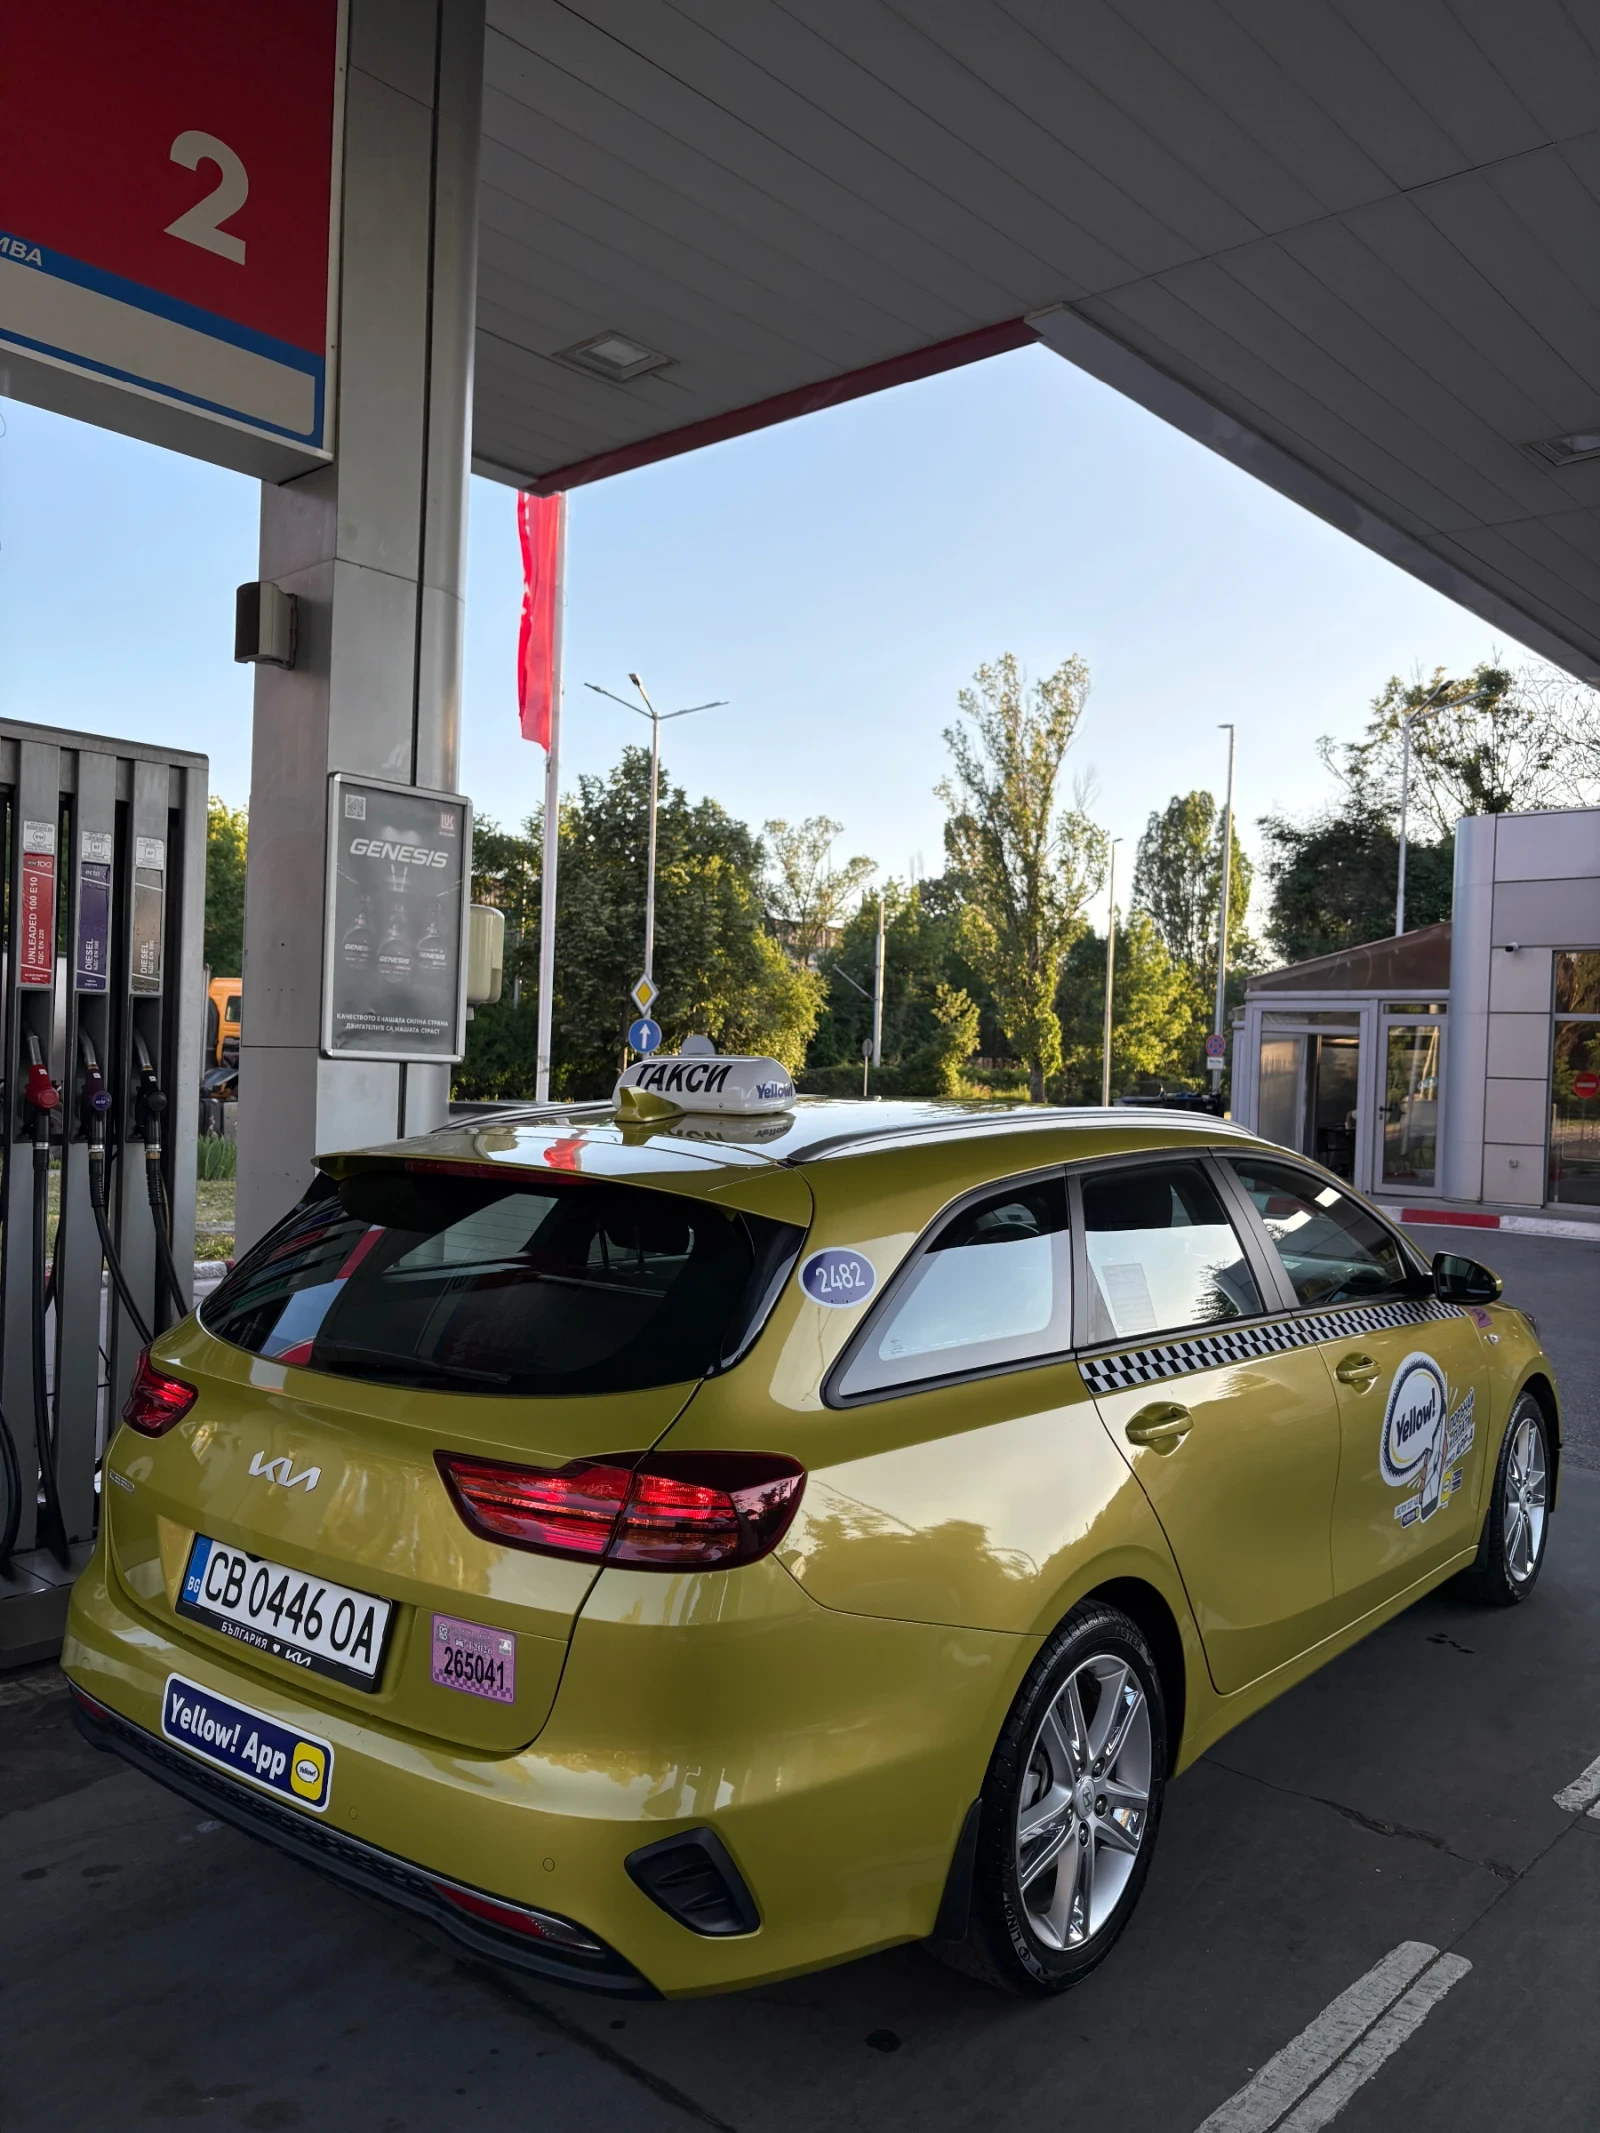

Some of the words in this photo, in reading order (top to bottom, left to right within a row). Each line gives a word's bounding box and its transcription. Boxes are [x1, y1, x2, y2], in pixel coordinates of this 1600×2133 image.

[164, 130, 249, 266] 2
[350, 838, 449, 868] GENESIS
[30, 877, 38, 893] E10
[30, 895, 38, 911] 100
[28, 913, 37, 964] UNLEADED
[85, 938, 94, 970] DIESEL
[140, 942, 148, 973] DIESEL
[636, 1063, 733, 1093] ТАКСИ
[815, 1262, 865, 1293] 2482
[1396, 1387, 1436, 1448] Yellow!
[248, 1450, 322, 1493] KIA
[187, 1576, 200, 1593] BG
[205, 1551, 246, 1609] CB
[248, 1567, 327, 1640] 0446
[330, 1597, 375, 1664] OA
[221, 1621, 269, 1650] БЪЛГАРИЯ
[285, 1649, 312, 1667] KIA
[444, 1646, 504, 1690] 265041
[171, 1693, 242, 1753] Yellow!
[241, 1731, 287, 1780] App
